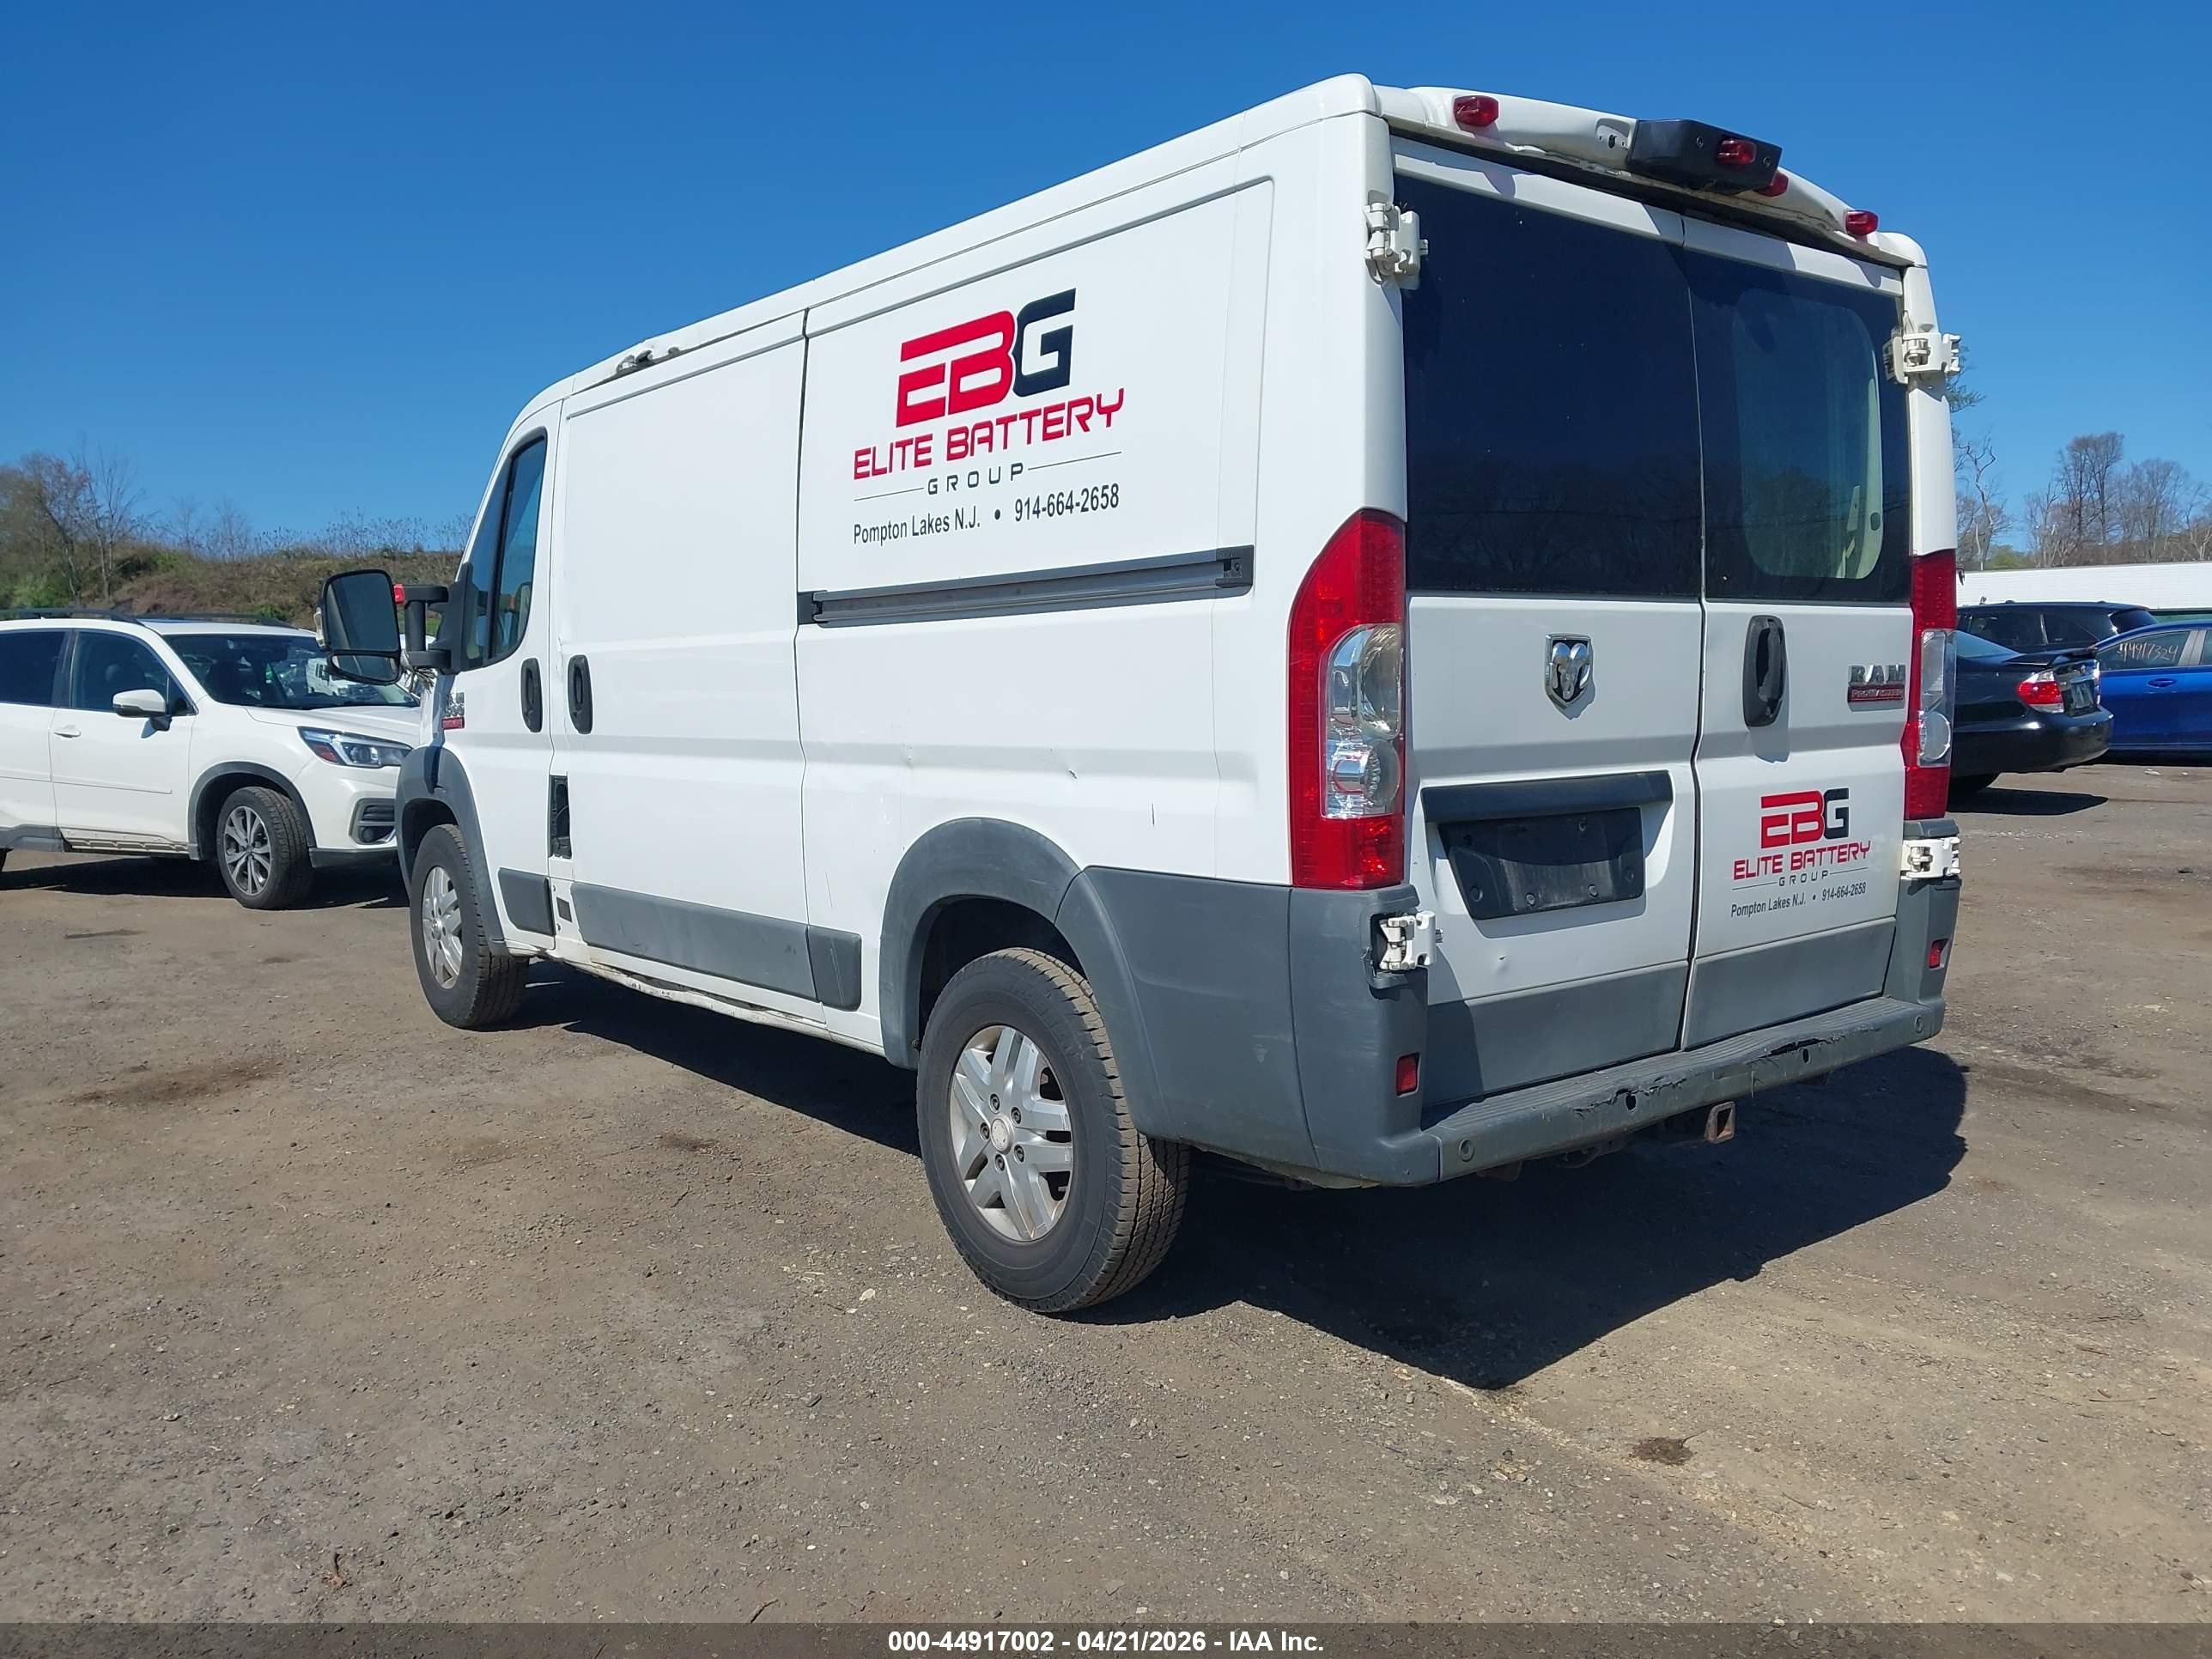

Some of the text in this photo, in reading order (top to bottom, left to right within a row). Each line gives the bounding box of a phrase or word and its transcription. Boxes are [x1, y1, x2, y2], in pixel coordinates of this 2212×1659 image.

[896, 288, 1076, 428] EBG
[853, 387, 1124, 480] ELITE BATTERY
[927, 462, 1024, 495] GROUP
[854, 483, 1120, 547] Pompton Lakes N.J. 914-664-2658
[1848, 664, 1905, 685] RAM
[1760, 787, 1849, 849] EBG
[1734, 840, 1871, 880] ELITE BATTERY
[1779, 871, 1829, 886] GROUP
[1731, 882, 1867, 917] Pompton Lakes N.J. 914-664-2658
